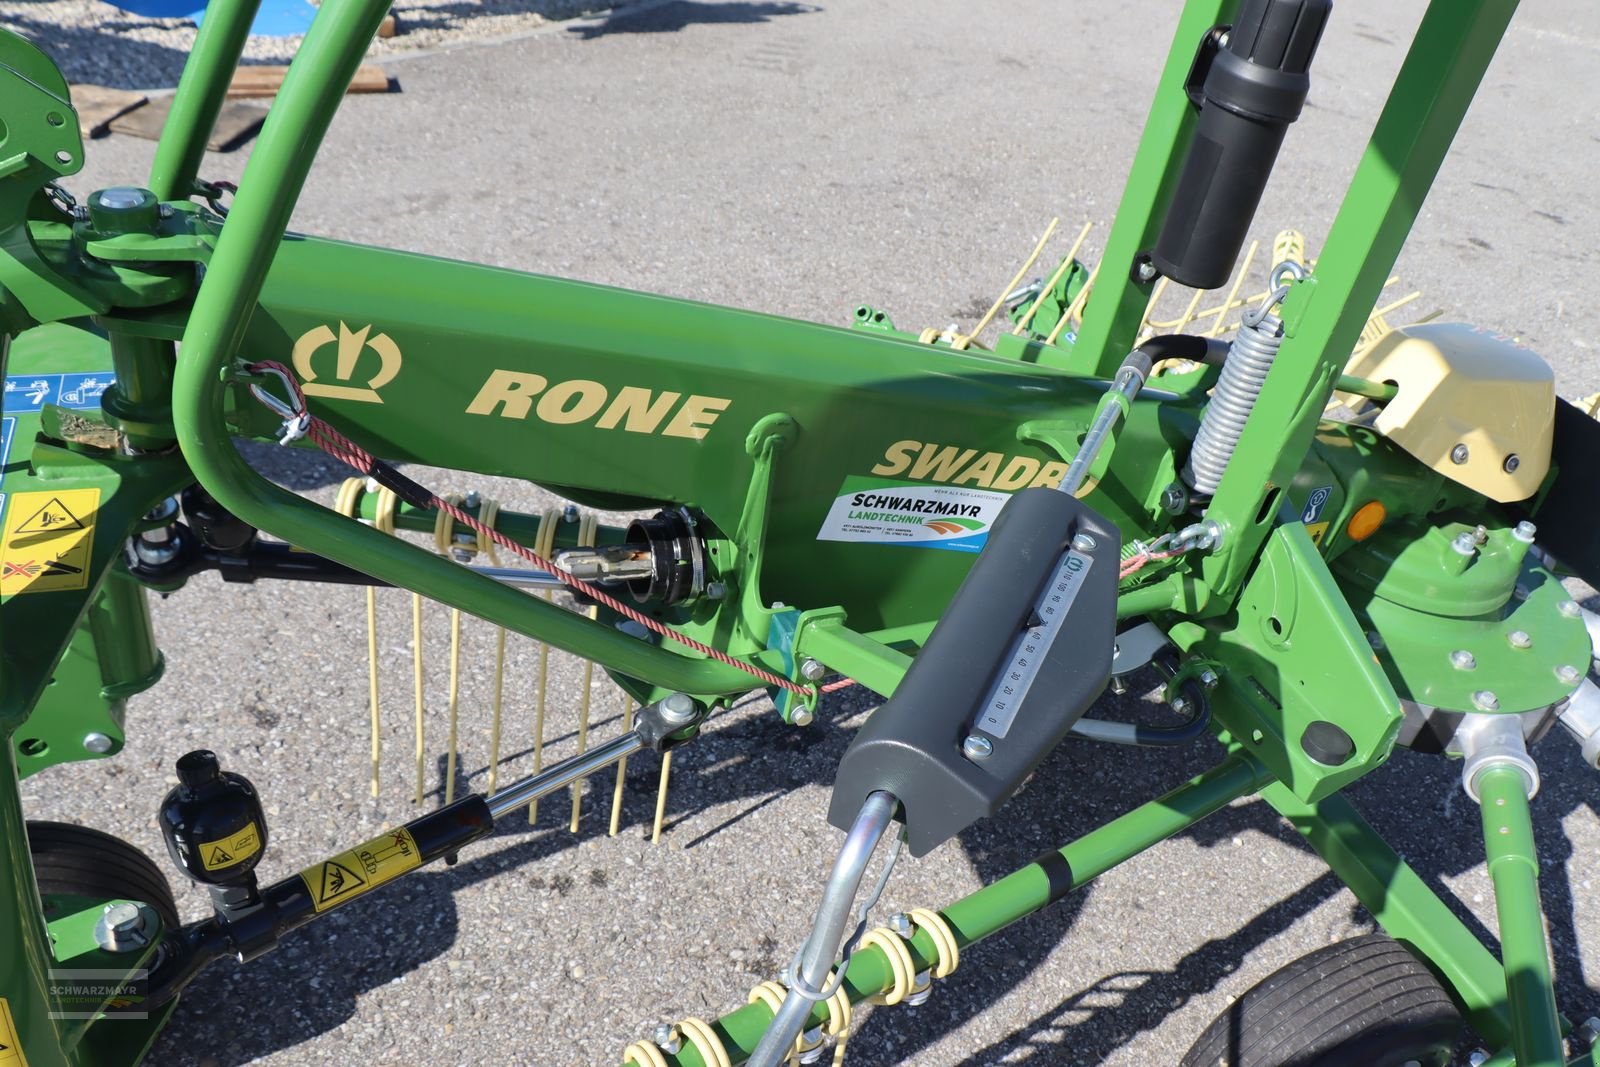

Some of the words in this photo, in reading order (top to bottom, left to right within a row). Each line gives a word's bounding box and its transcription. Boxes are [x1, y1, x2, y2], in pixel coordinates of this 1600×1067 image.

[465, 369, 732, 440] RONE
[851, 493, 981, 518] SCHWARZMAYR
[848, 510, 925, 525] LANDTECHNIK
[1025, 644, 1035, 653] 50
[1018, 658, 1028, 667] 40
[1011, 672, 1021, 681] 30
[1003, 686, 1014, 695] 20
[995, 701, 1006, 710] 10
